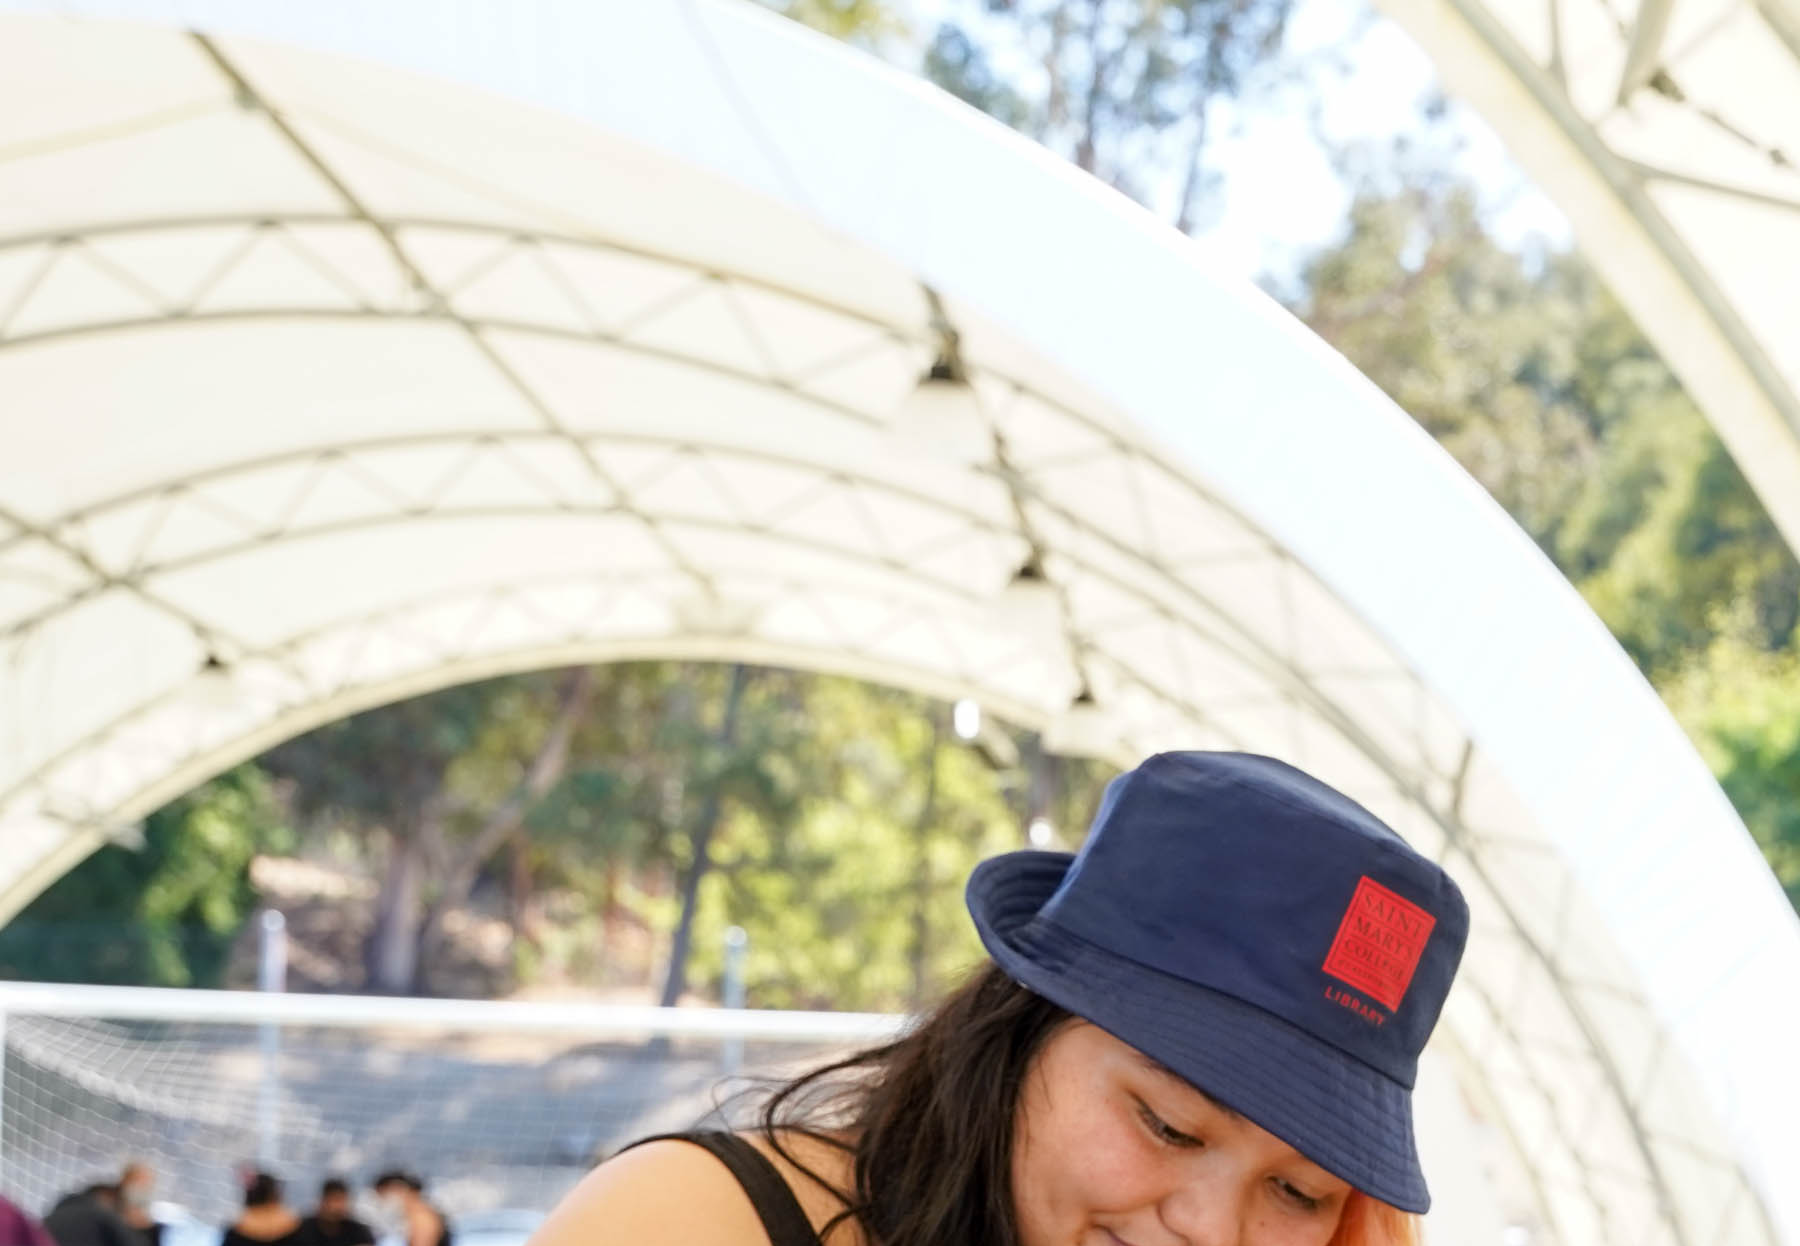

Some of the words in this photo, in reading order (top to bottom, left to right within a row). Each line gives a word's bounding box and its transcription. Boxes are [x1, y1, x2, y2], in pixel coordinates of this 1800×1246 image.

[1364, 895, 1422, 937] SAINT
[1344, 939, 1403, 980] COLLEGE
[1324, 986, 1385, 1025] LIBRARY
